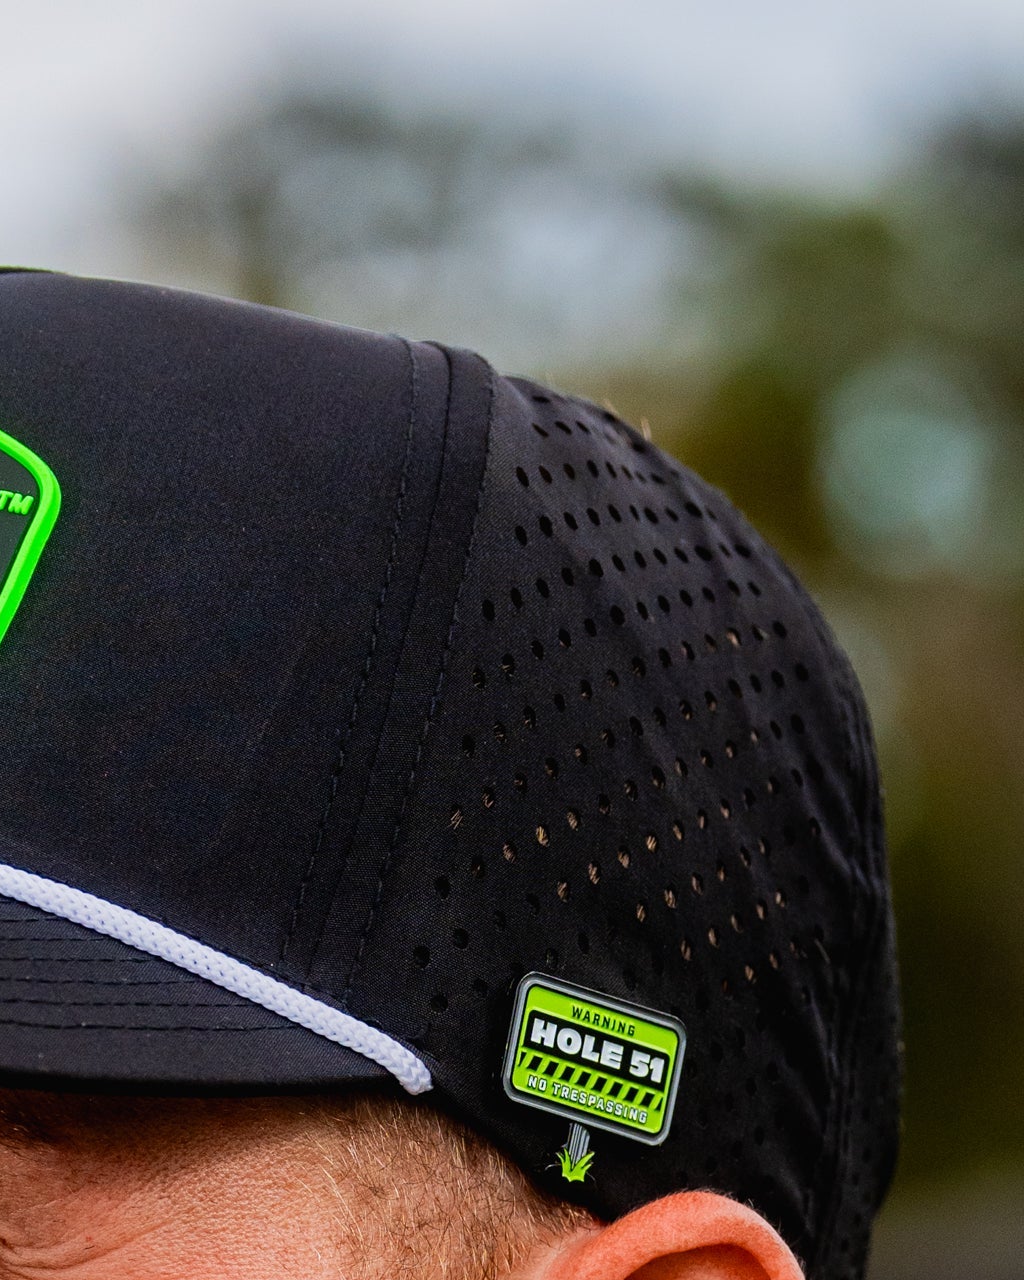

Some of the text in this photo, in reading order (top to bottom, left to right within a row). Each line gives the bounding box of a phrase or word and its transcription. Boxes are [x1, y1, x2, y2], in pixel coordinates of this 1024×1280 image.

[571, 1005, 636, 1037] WARNING
[530, 1018, 665, 1083] HOLE 51
[527, 1075, 648, 1125] NO TRESPASSING
